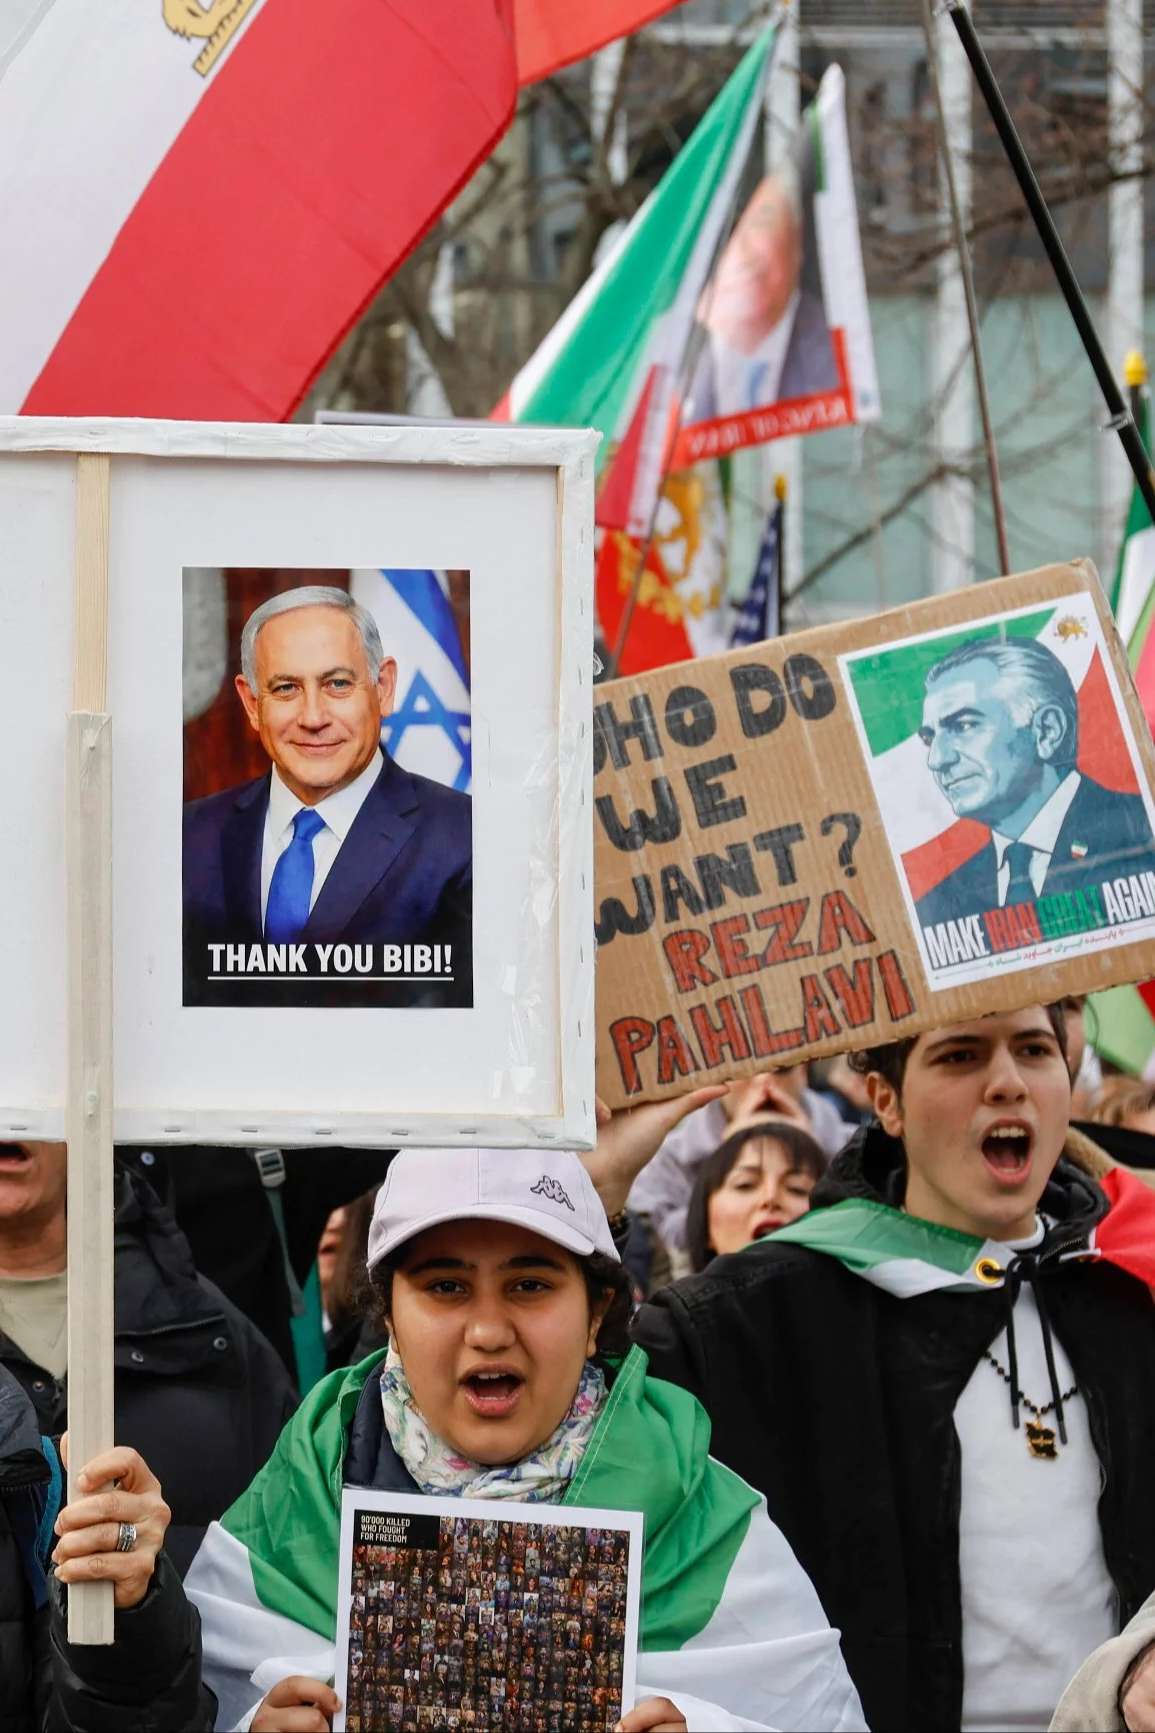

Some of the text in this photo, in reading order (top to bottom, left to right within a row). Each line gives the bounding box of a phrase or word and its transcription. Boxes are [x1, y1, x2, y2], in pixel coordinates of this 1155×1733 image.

[729, 653, 837, 739] DO
[595, 753, 748, 852] WE
[207, 943, 452, 973] THANK YOU BIBI!
[662, 890, 877, 994] REZA
[923, 914, 991, 969] MAKE
[983, 901, 1044, 953] IRAN
[1036, 885, 1105, 940] GREAT
[609, 948, 916, 1096] PAHLAVI
[360, 1514, 411, 1528] 90'000 KILLED
[360, 1523, 405, 1535] WHO FOUGHT
[360, 1532, 407, 1544] FOR FREEDOM
